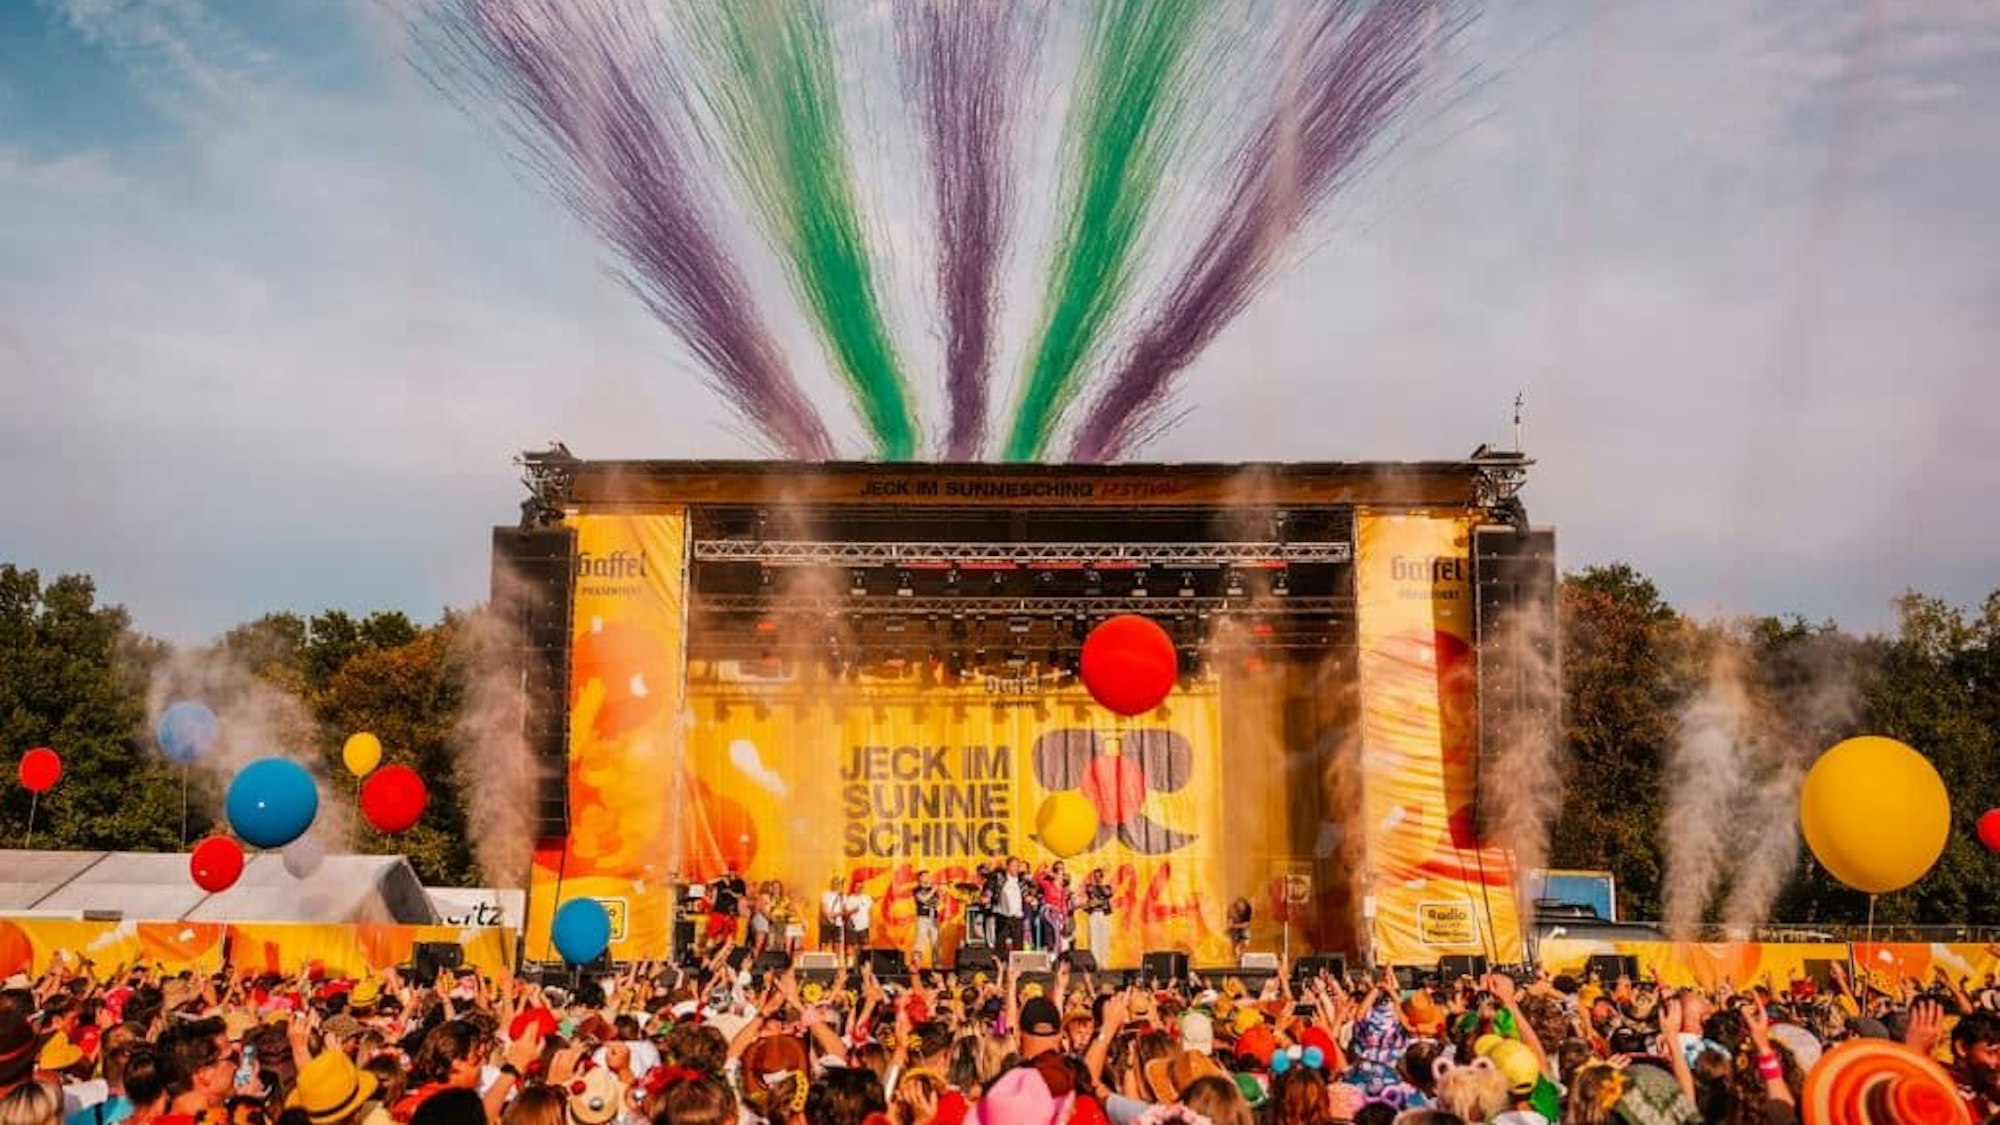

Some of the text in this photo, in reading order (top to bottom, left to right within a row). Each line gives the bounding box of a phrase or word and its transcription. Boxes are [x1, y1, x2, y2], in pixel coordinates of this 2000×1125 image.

[860, 481, 910, 497] JECK
[916, 482, 939, 496] IM
[945, 481, 1093, 497] SUNNESCHING
[841, 746, 1009, 781] JECK IM
[844, 784, 1009, 819] SUNNE
[844, 822, 1008, 858] SCHING
[1428, 908, 1467, 920] Radio
